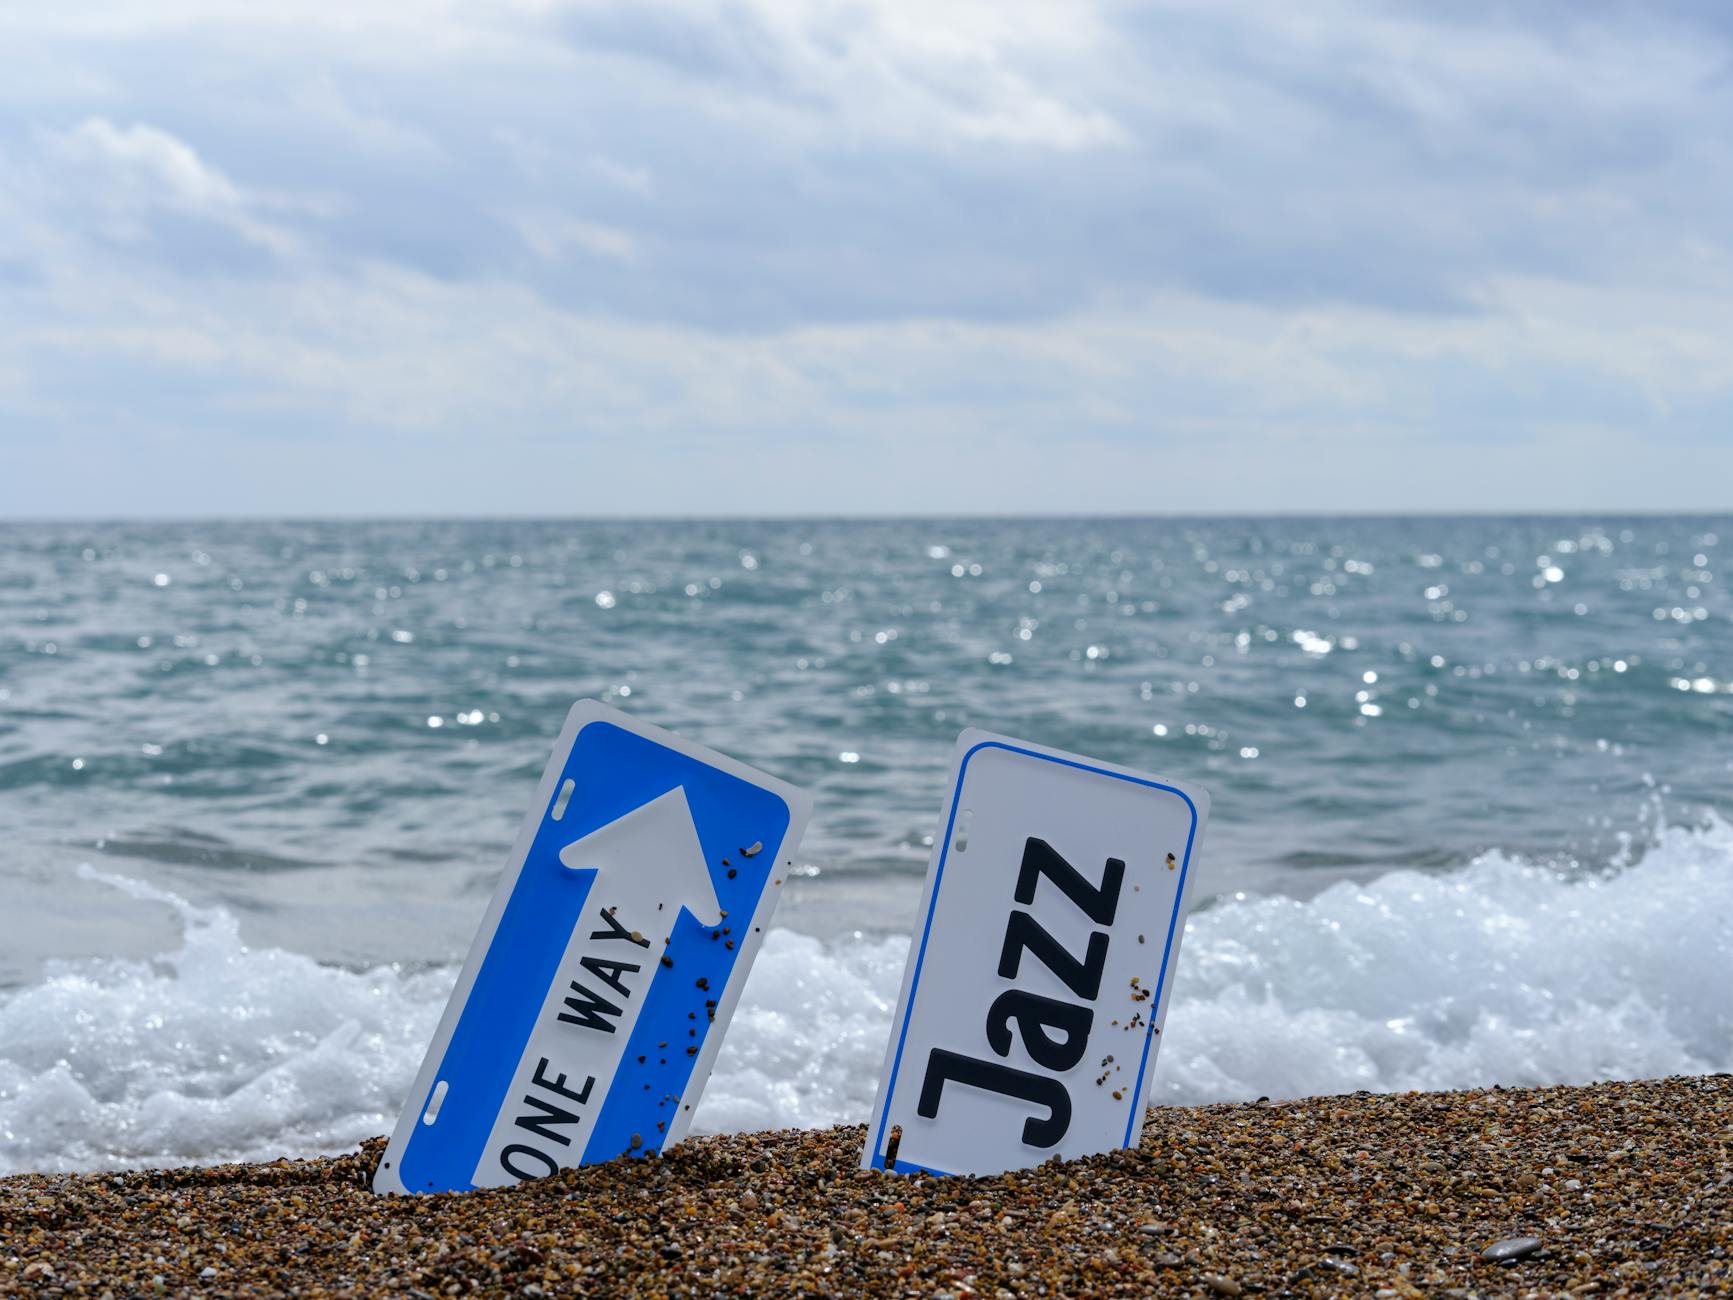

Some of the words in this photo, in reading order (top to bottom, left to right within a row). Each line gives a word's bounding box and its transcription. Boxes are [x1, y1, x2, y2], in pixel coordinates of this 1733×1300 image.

[500, 1056, 596, 1181] ONE
[557, 907, 651, 1034] WAY
[917, 836, 1126, 1149] Jazz
